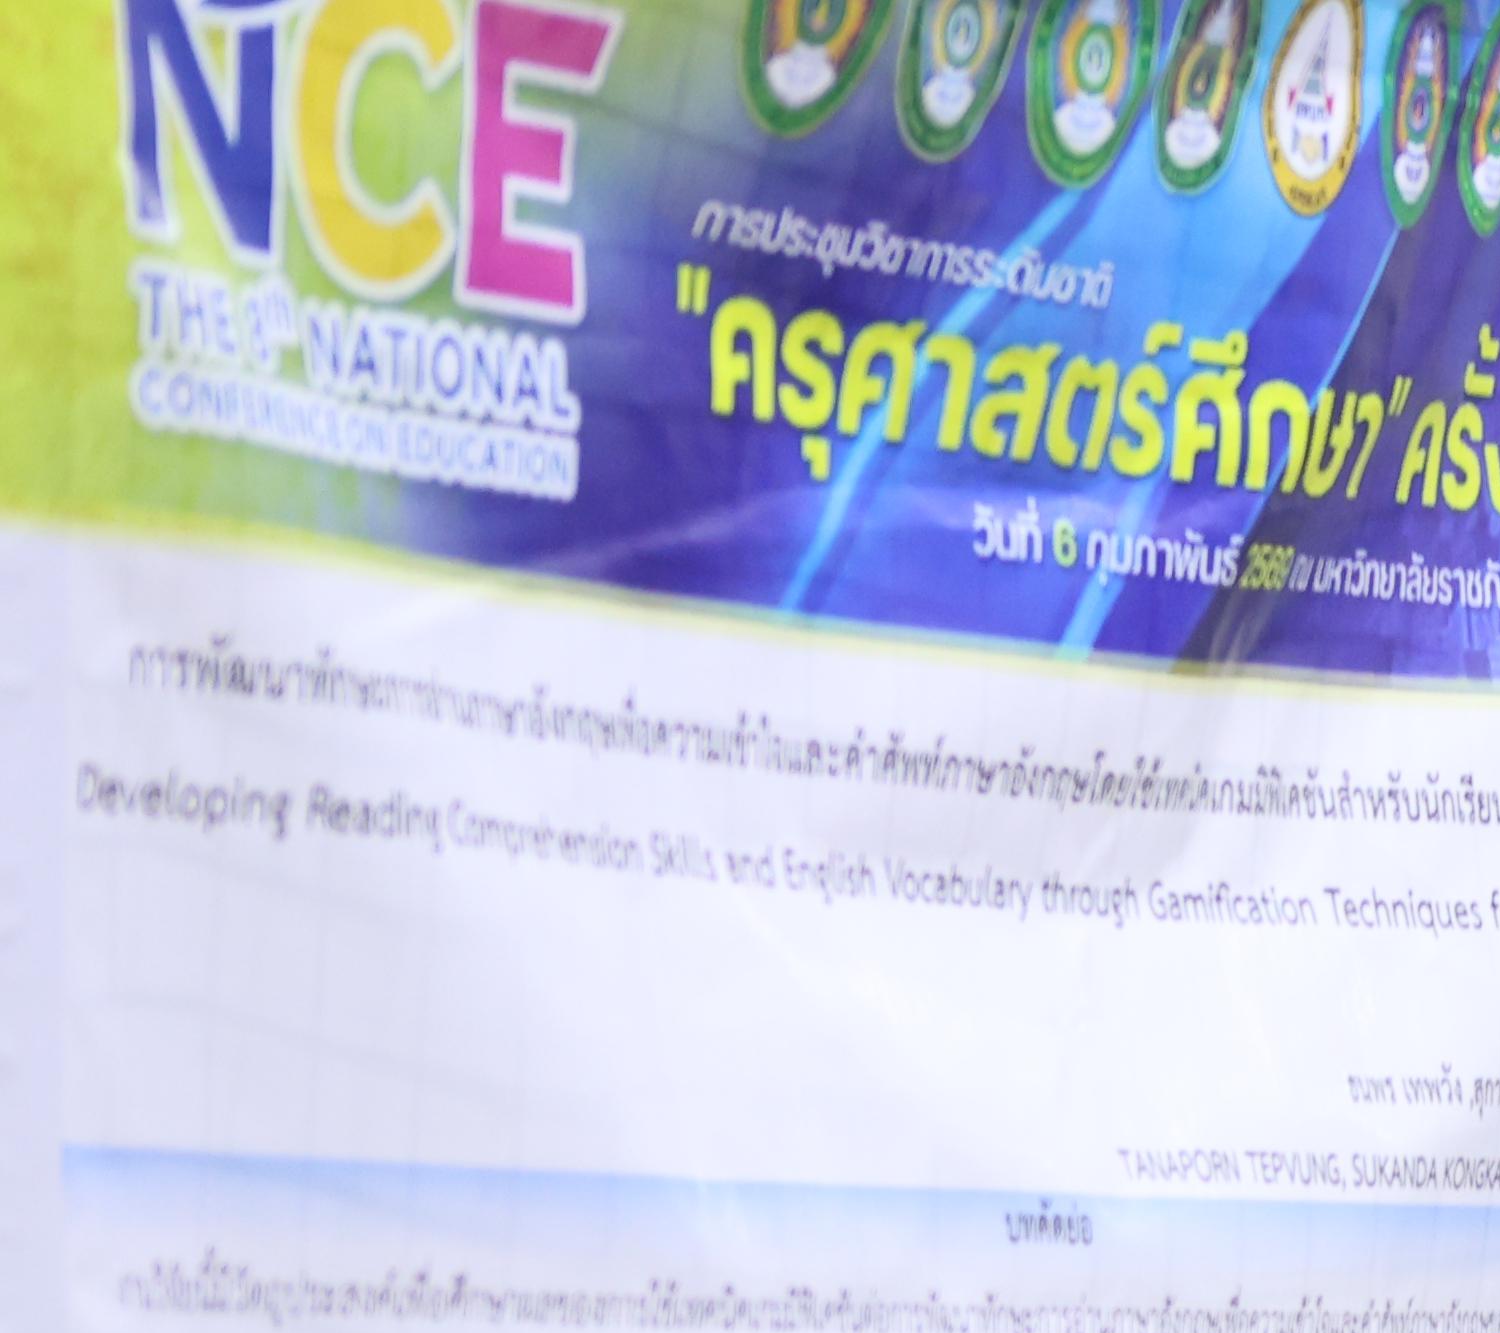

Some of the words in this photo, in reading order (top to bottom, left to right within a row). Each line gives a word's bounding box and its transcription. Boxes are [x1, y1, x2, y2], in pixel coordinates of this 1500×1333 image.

[118, 0, 616, 312] NCE
[692, 198, 1114, 308] การประชุมวิชาการระดับชาติ
[137, 271, 238, 353] THE
[307, 314, 580, 422] NATIONAL
[399, 420, 572, 490] EDUCATION
[972, 502, 1043, 564] วันที่
[1051, 520, 1079, 571] 6
[1084, 530, 1239, 600] กุมภาพันธ์
[76, 762, 294, 844] Developing
[305, 780, 443, 856] Reading
[446, 799, 641, 874] Comprehension
[650, 830, 716, 884] Skills
[726, 842, 777, 889] and
[783, 847, 878, 907] English
[884, 856, 1032, 922] Vocabulary
[1041, 866, 1140, 930] through
[1147, 878, 1318, 930] Gamification
[1323, 886, 1485, 940] Techniques
[1117, 1147, 1240, 1184] TANAPORN
[1243, 1151, 1347, 1191] TEPVUNG,
[1352, 1153, 1439, 1189] SUKANDA
[1004, 1200, 1094, 1247] บทคัดย่อ
